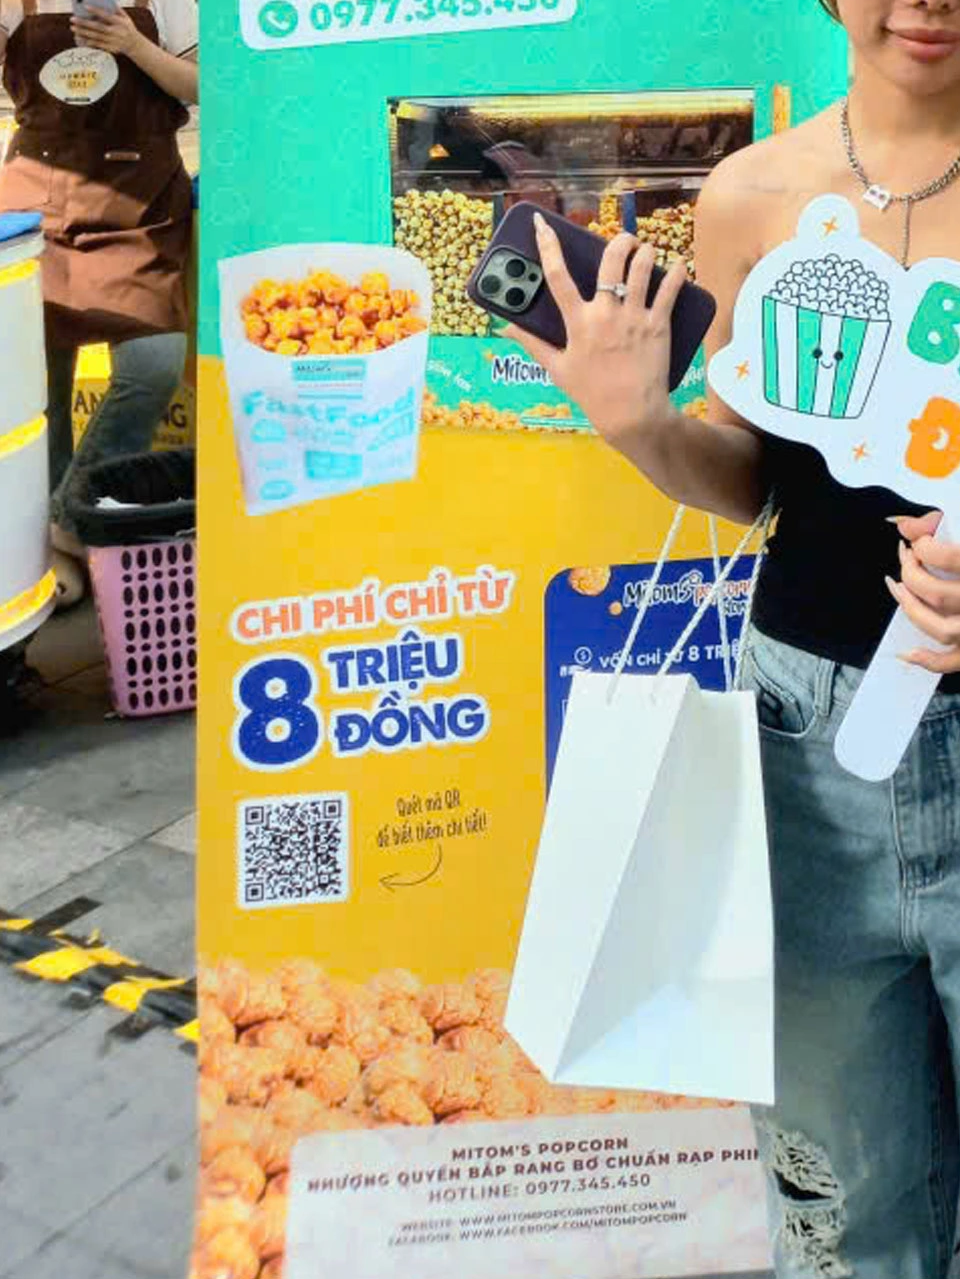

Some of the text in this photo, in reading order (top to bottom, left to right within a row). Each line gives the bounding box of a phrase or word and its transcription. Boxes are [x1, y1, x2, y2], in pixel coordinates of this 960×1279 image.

[235, 571, 511, 641] CHI PHÍ CHỈ TỪ
[328, 629, 460, 691] TRIỆU
[637, 648, 661, 667] CHỈ
[688, 645, 700, 662] 8
[237, 656, 321, 767] 8
[334, 692, 486, 753] ĐỒNG
[444, 788, 461, 810] QR
[451, 1137, 629, 1162] MITOM'S POPCORN
[513, 1160, 566, 1176] RANG
[573, 1155, 601, 1172] BƠ
[605, 1148, 671, 1169] CHUẨN
[676, 1149, 715, 1167] RẠP
[428, 1172, 651, 1204] HOTLINE: 0977.345.450
